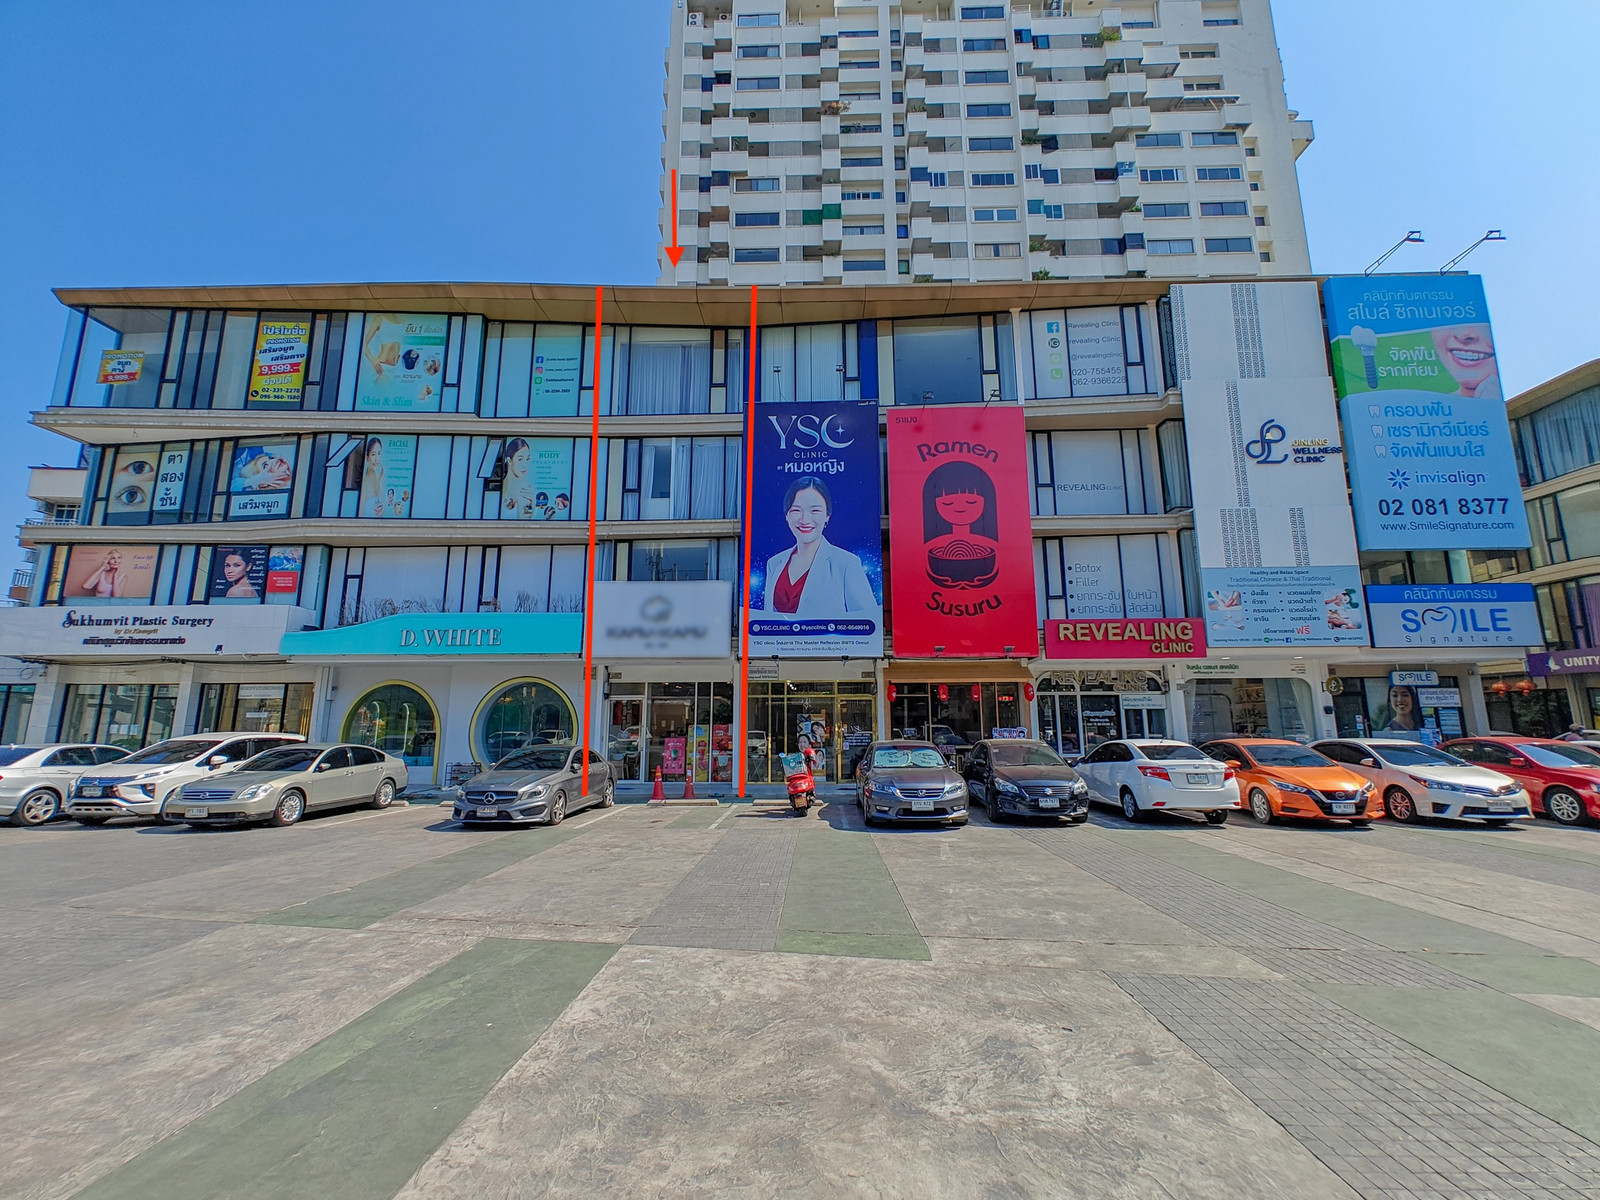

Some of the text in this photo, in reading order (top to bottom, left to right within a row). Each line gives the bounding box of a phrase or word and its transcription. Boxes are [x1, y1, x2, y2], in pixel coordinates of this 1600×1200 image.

[1363, 290, 1454, 301] คลินิกทันตกรรม
[1347, 301, 1477, 320] สไมล์ ซิกเนเจอร์
[263, 323, 306, 335] โปรโมชั่น
[1101, 320, 1120, 328] Clinic
[266, 337, 301, 345] PROMOTION
[259, 345, 295, 354] เสริมจมูก
[1389, 345, 1436, 361] จัดฟัน
[1072, 367, 1122, 376] 020-755455
[1378, 362, 1439, 377] รากเทียม
[361, 396, 413, 407] Skin & Slim
[1384, 400, 1452, 418] ครอบฟัน
[768, 413, 855, 450] YSC
[1387, 421, 1490, 438] เซรามิกวีเนียร์
[1292, 438, 1329, 446] JINLING
[793, 451, 828, 459] CLINIC
[916, 440, 999, 463] Ramen
[1292, 446, 1343, 455] WELLNESS
[1389, 440, 1486, 458] จัดฟันแบบใส
[167, 454, 183, 465] ตา
[1294, 455, 1326, 464] CLINIC
[784, 459, 845, 475] หมอหญิง
[160, 472, 184, 483] สอง
[1415, 470, 1486, 487] invisalign
[1057, 483, 1106, 492] REVEALING
[159, 487, 177, 507] ชั้น
[238, 499, 280, 513] เสริมจมูก
[1378, 498, 1509, 516] 02 081 8377
[1380, 520, 1514, 532] www.SmileSignature.com
[1074, 563, 1102, 573] Botox
[1075, 577, 1099, 587] Filler
[1077, 588, 1158, 601] ยกกระชับ ใบหน้า
[1404, 587, 1498, 600] คลินิกทันตกรรม
[925, 591, 1003, 617] Susuru
[1078, 601, 1162, 614] ยกกระชับ สัดส่วน
[62, 609, 214, 629] Sukhumvit Plastic Surgery
[1400, 605, 1512, 633] SMILE
[1058, 621, 1193, 641] REVEALING
[1296, 624, 1311, 635] ฟรี
[400, 628, 502, 647] D. WHITE
[1405, 635, 1513, 645] Signature
[1151, 642, 1194, 653] CLINIC
[1563, 655, 1600, 667] UNITY
[1050, 670, 1148, 685] REVEALING
[1114, 683, 1148, 692] CLINIC
